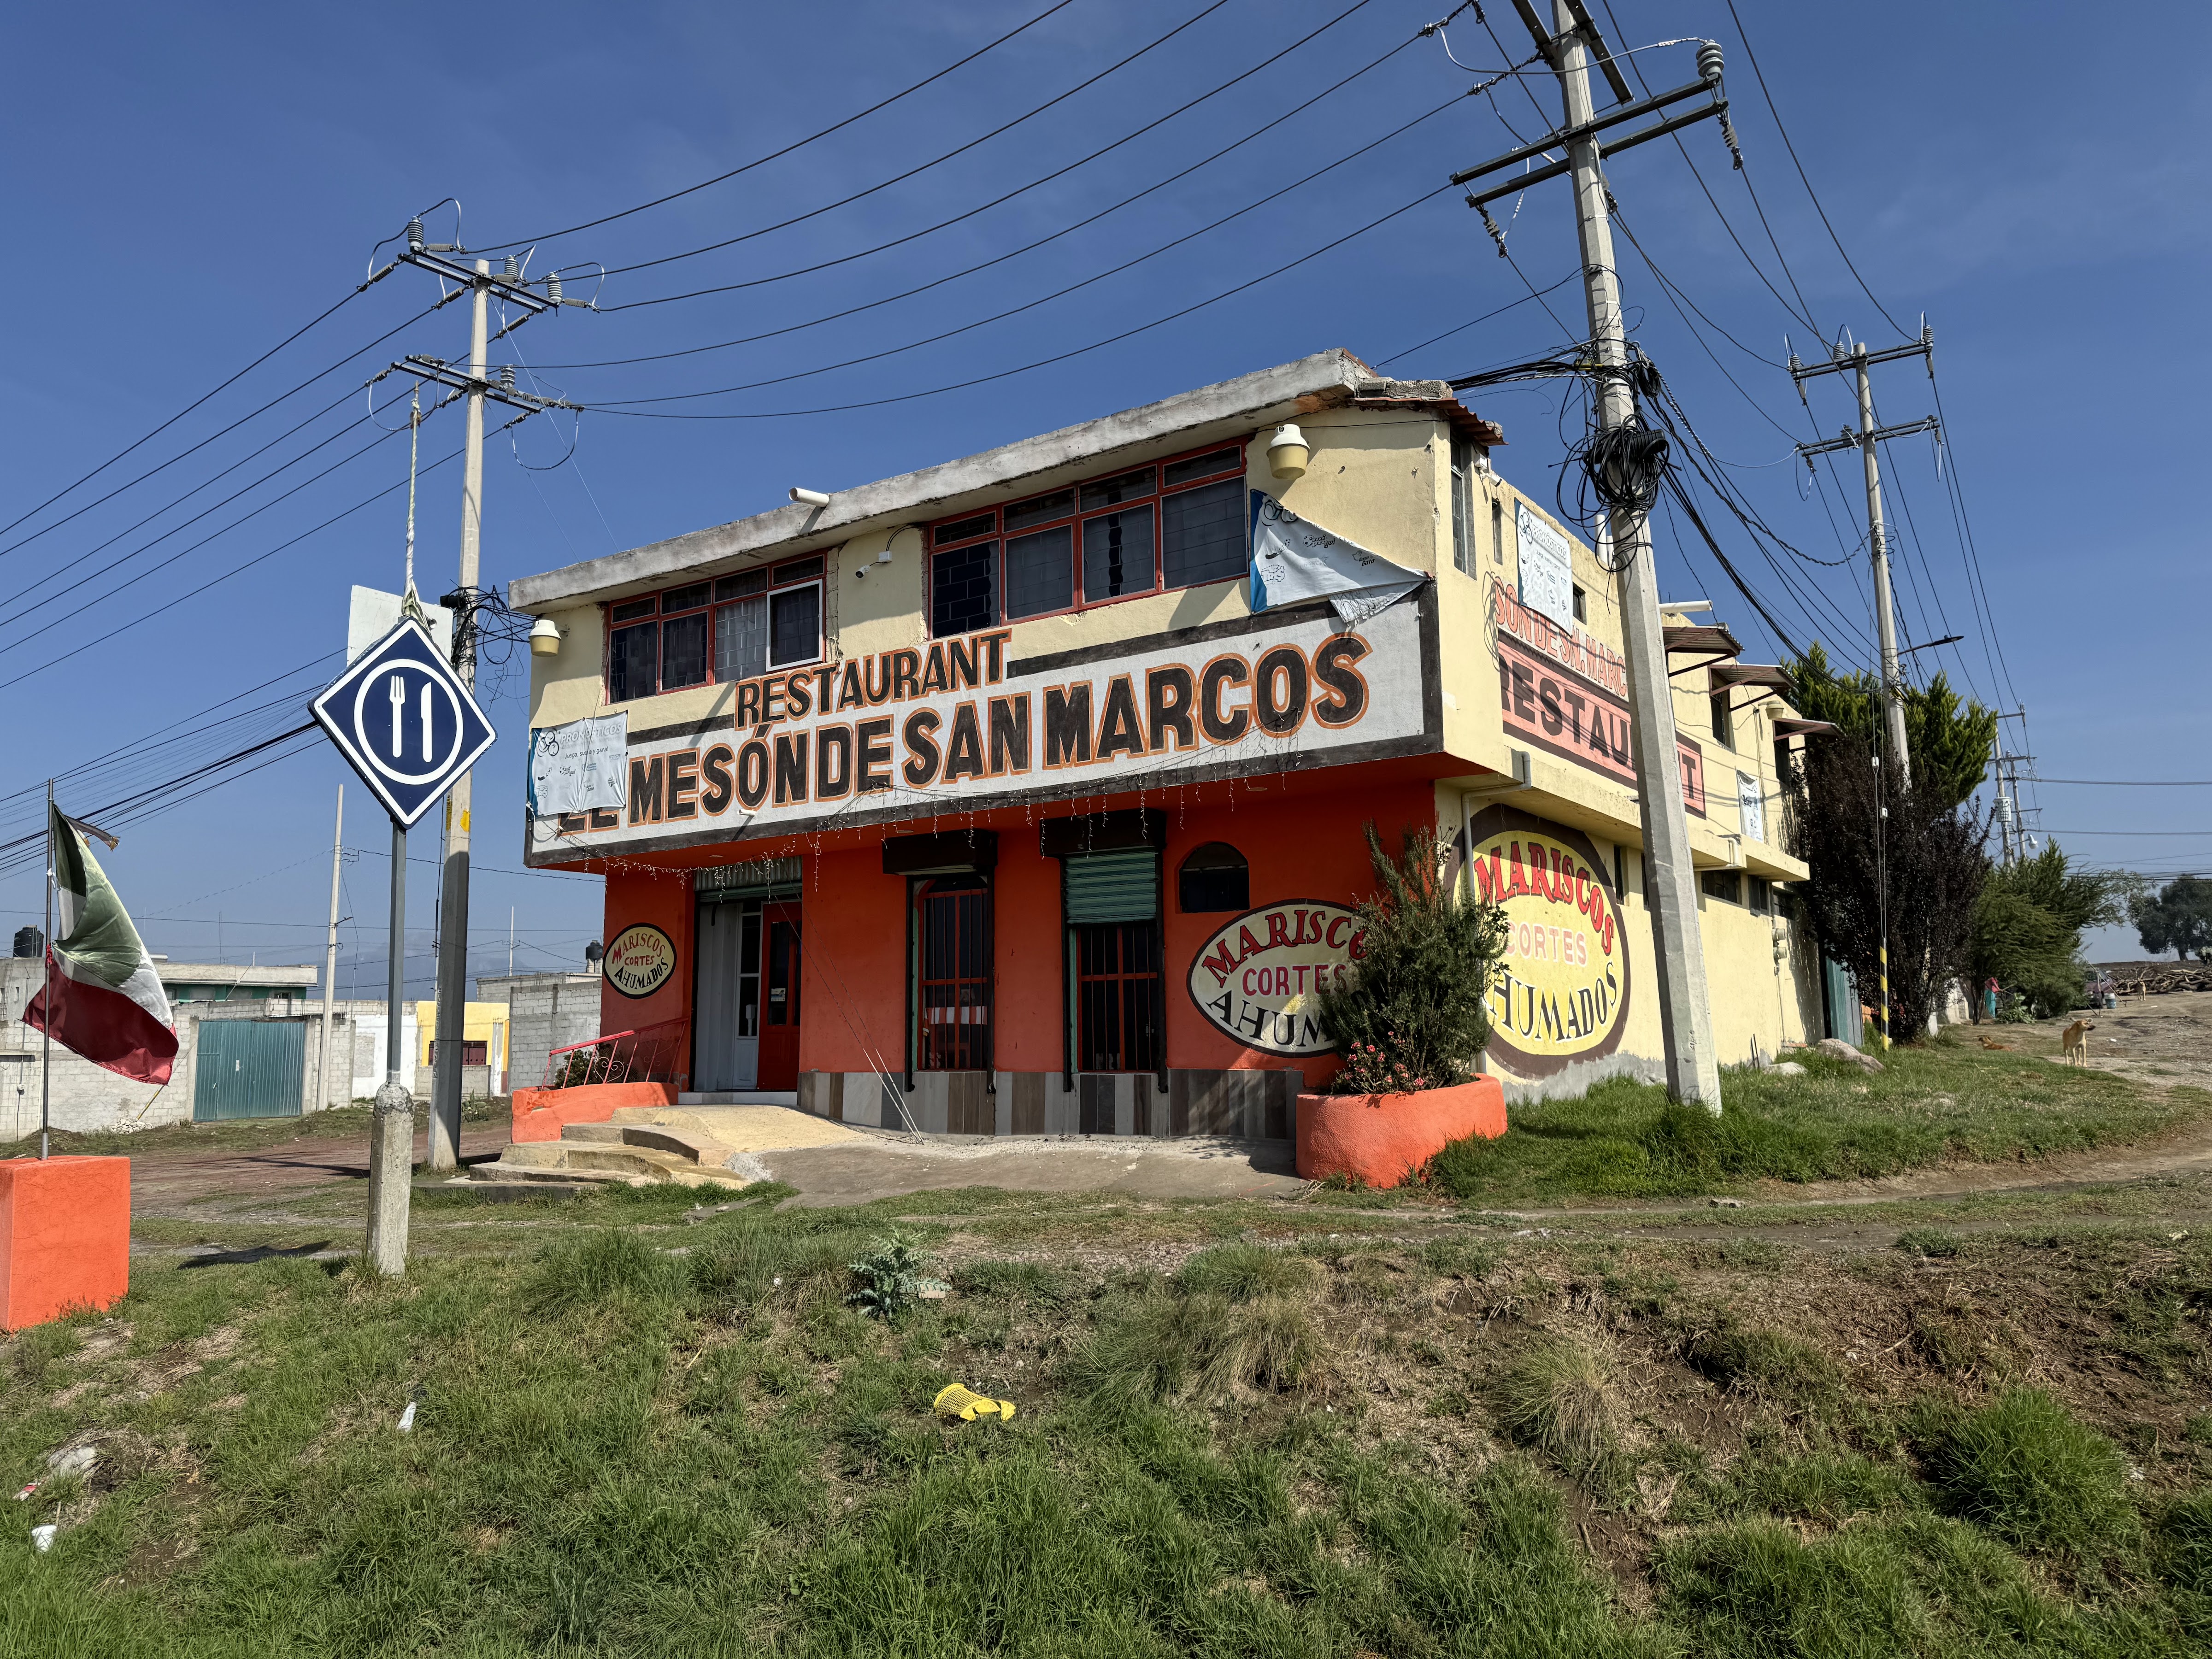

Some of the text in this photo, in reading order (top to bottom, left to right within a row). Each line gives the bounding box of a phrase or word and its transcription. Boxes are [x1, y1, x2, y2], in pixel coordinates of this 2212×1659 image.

[735, 628, 1012, 730] RESTAURANT
[1586, 633, 1626, 697] MARC
[627, 631, 1373, 828] MESÓN DE SAN MARCOS
[1474, 841, 1614, 956] MARISCOS
[612, 932, 665, 965] MARISCOS
[614, 957, 669, 990] AHUMADOS
[624, 954, 655, 966] CORTES
[1201, 909, 1368, 988] MARISCO
[1242, 964, 1347, 996] CORTES
[1206, 989, 1335, 1047] AHUM
[1483, 960, 1617, 1042] HUMADOS
